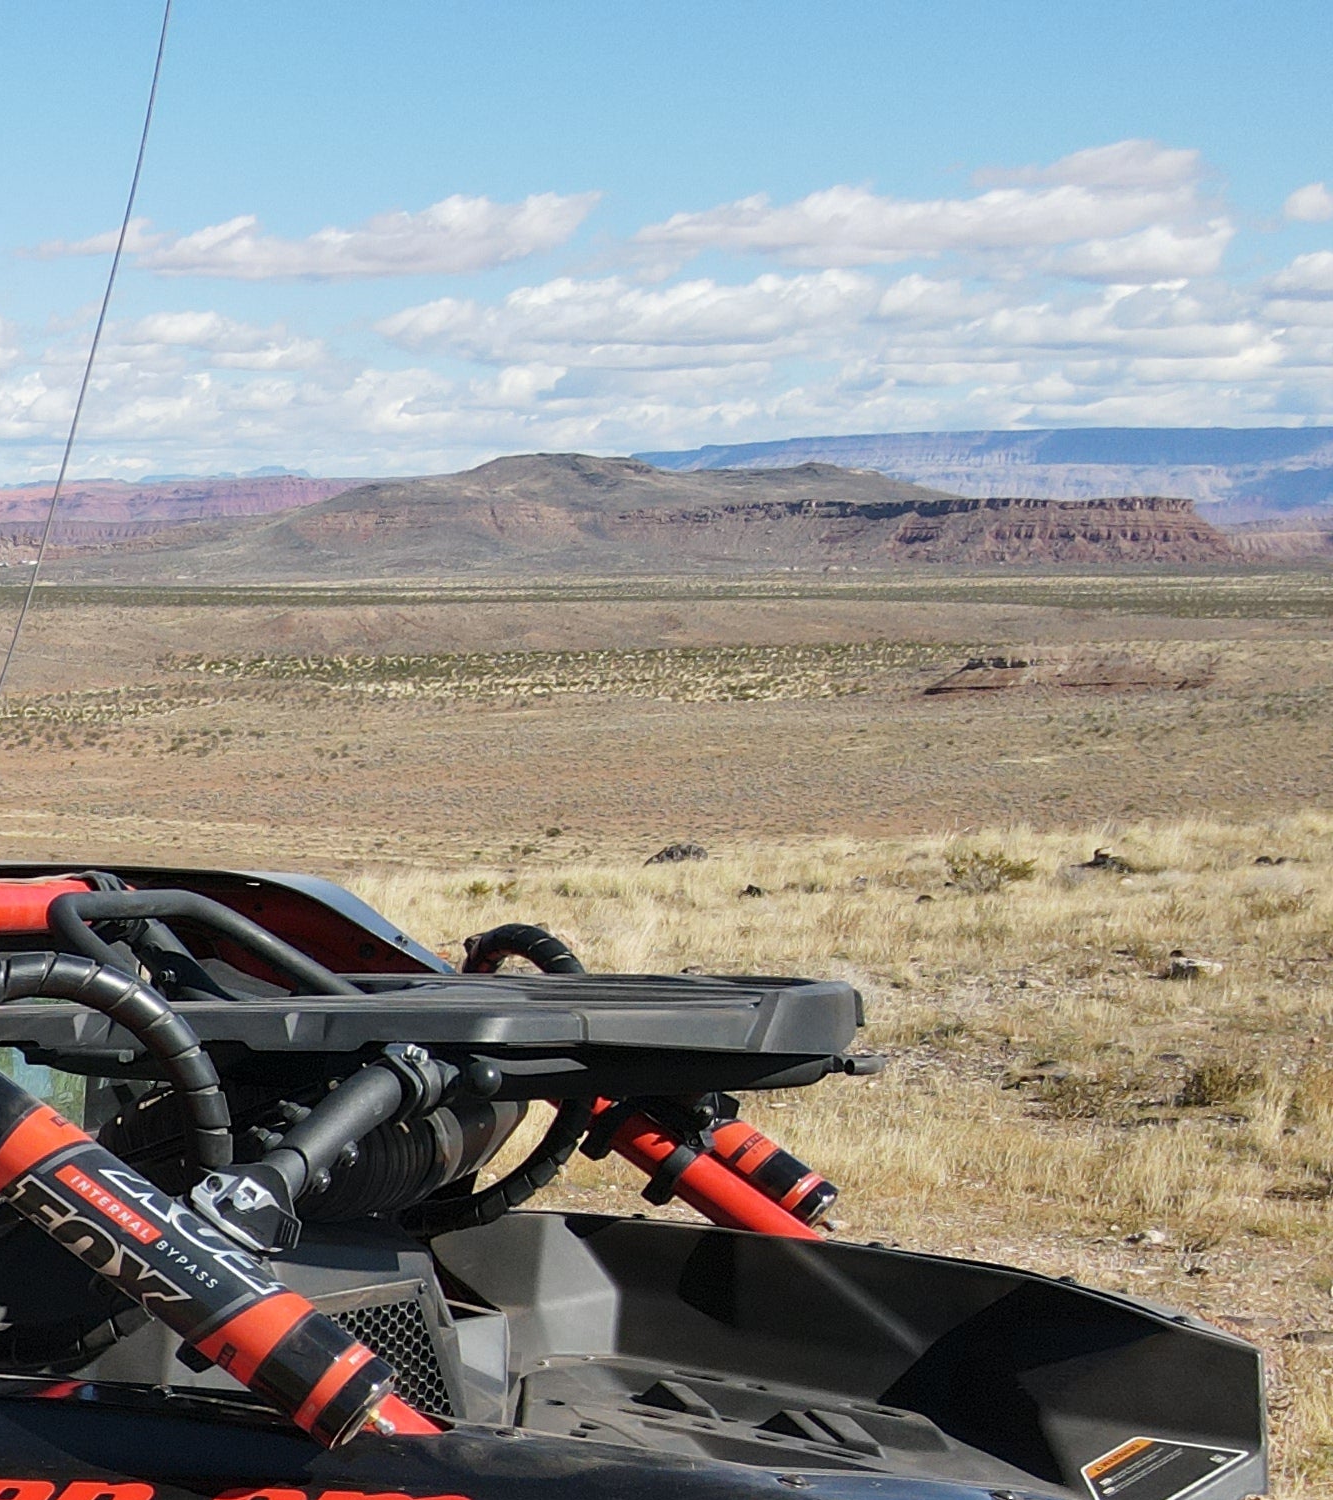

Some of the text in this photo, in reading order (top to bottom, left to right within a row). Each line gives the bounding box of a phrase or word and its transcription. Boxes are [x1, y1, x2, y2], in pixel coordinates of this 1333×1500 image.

[10, 1174, 193, 1310] FOX
[69, 1174, 219, 1290] INTERNAL BYPASS
